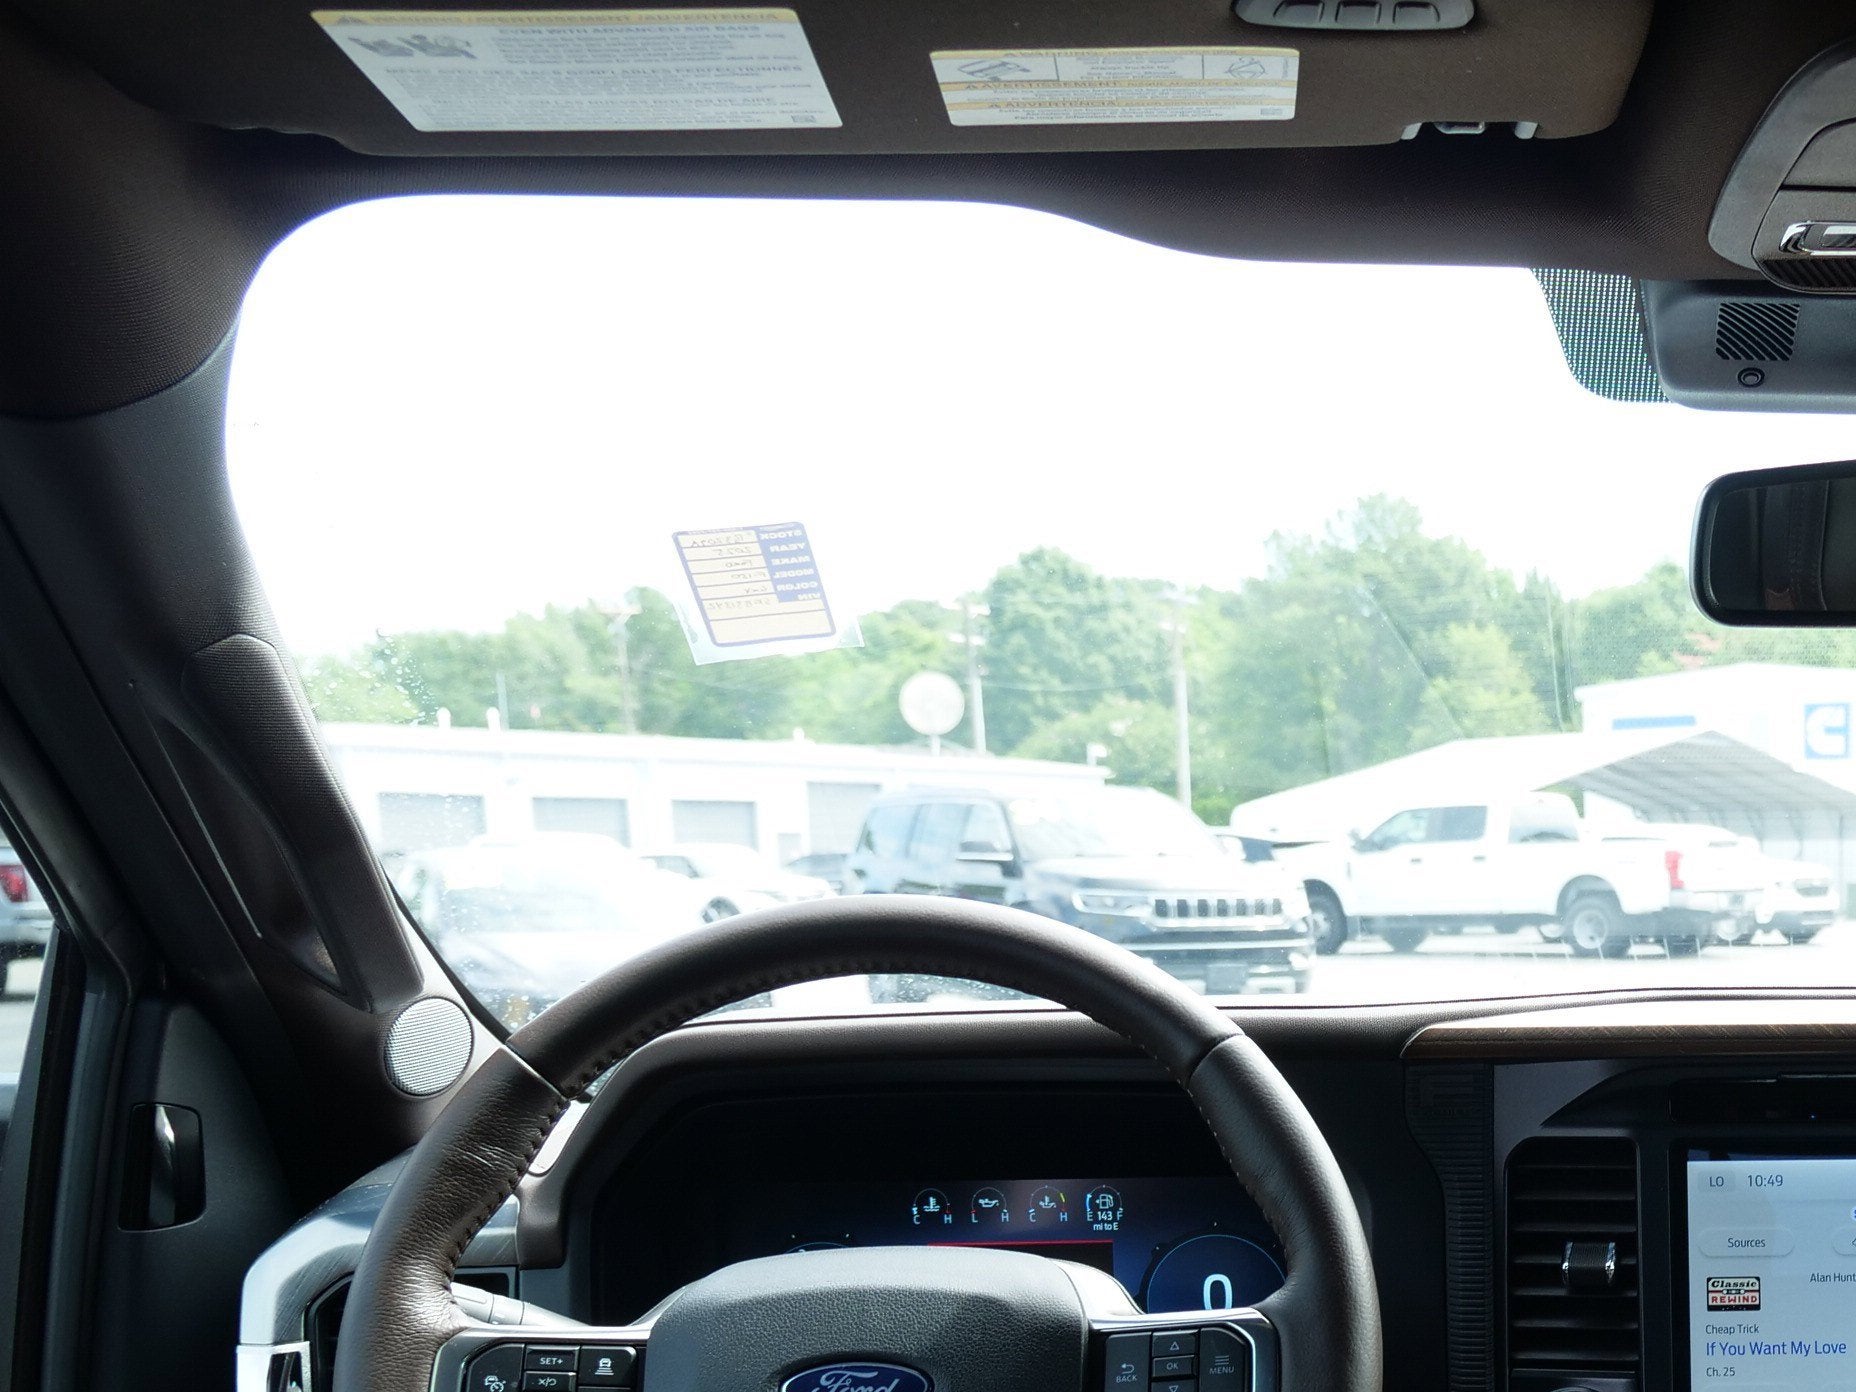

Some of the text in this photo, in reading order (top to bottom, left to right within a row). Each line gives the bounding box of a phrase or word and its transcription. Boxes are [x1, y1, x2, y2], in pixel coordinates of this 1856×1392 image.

[1708, 1176, 1725, 1188] LO
[1747, 1174, 1784, 1188] 10:49
[1097, 1211, 1113, 1221] 143
[1727, 1237, 1766, 1248] Sources
[1809, 1272, 1832, 1283] Alan
[1710, 1279, 1758, 1290] Classic
[1709, 1295, 1759, 1306] REWIND
[1705, 1323, 1760, 1336] Cheap Trick
[1706, 1340, 1847, 1357] If You Want My Love
[540, 1357, 564, 1366] SET+
[1166, 1362, 1179, 1371] OK
[1209, 1365, 1235, 1375] MENU
[1723, 1366, 1736, 1377] 25
[1116, 1374, 1138, 1384] BACK
